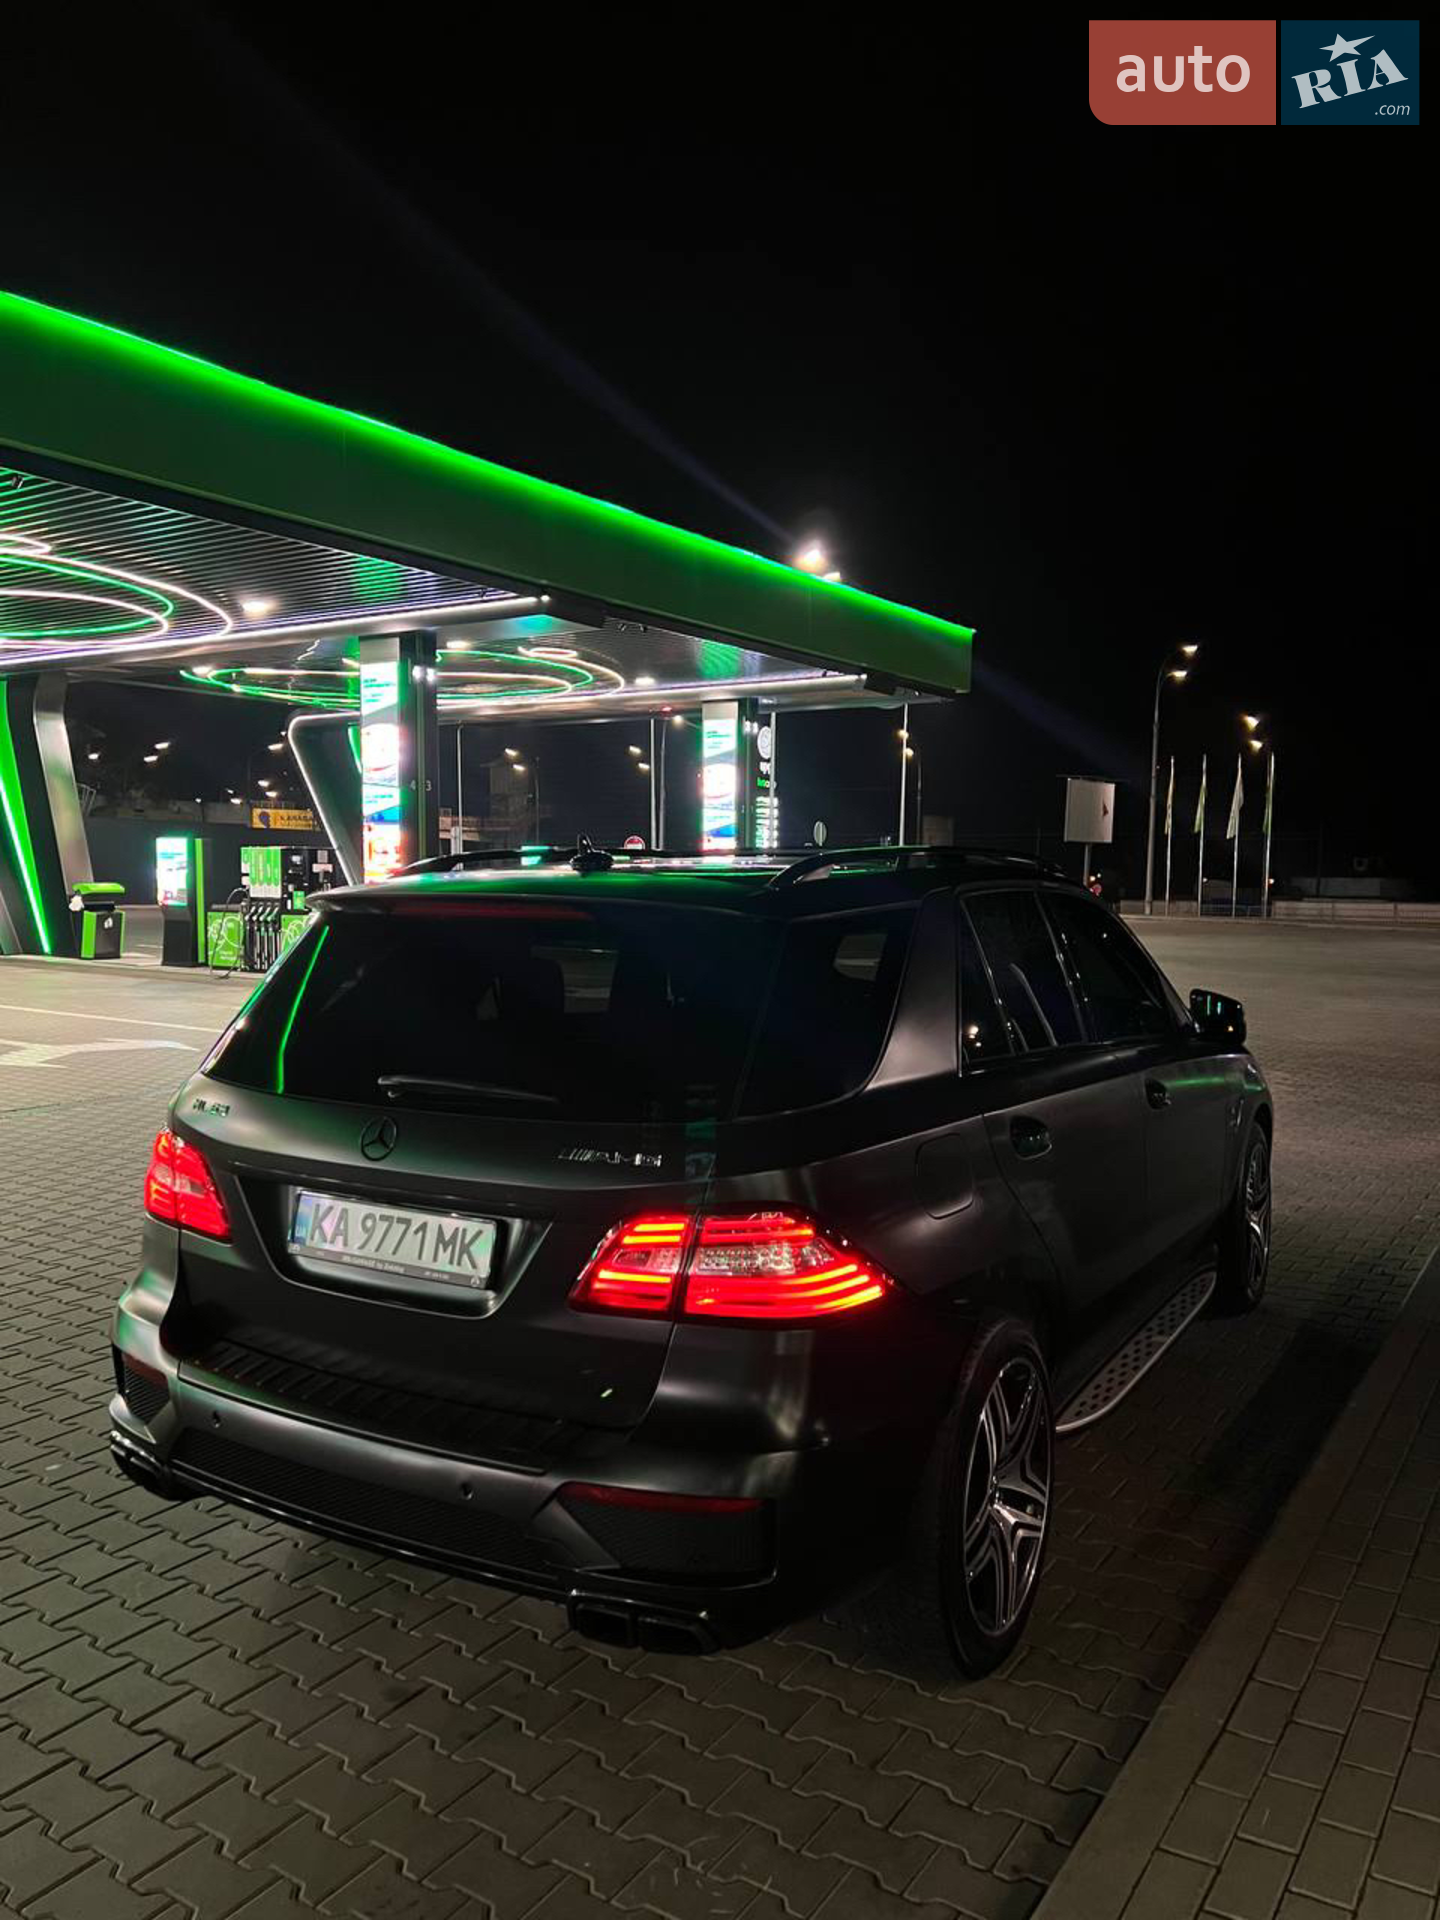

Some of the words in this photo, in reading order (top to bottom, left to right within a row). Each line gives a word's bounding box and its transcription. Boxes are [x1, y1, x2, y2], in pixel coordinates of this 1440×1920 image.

[425, 779, 433, 792] 3
[310, 1203, 349, 1247] KA
[358, 1213, 427, 1260] 9771
[433, 1223, 484, 1269] MK
